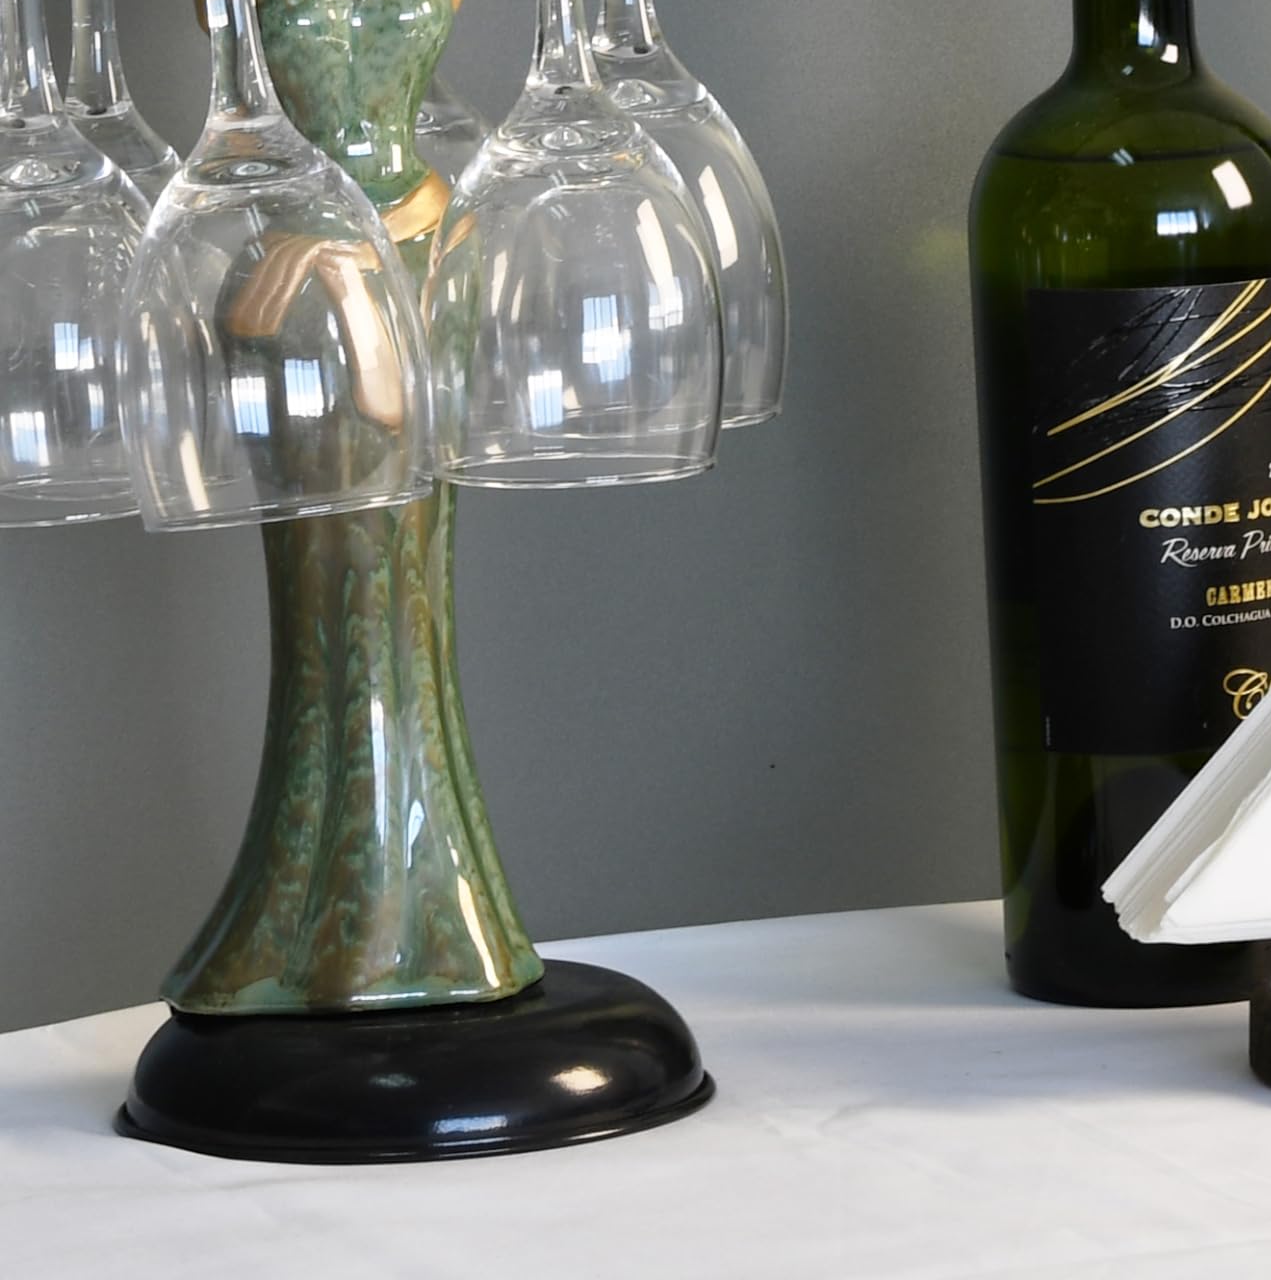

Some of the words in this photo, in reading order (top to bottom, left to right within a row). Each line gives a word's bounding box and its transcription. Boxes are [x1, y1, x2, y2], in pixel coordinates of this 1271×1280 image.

[1139, 502, 1240, 528] CONDE
[1160, 537, 1237, 568] Reserva
[1170, 616, 1200, 629] D.O.
